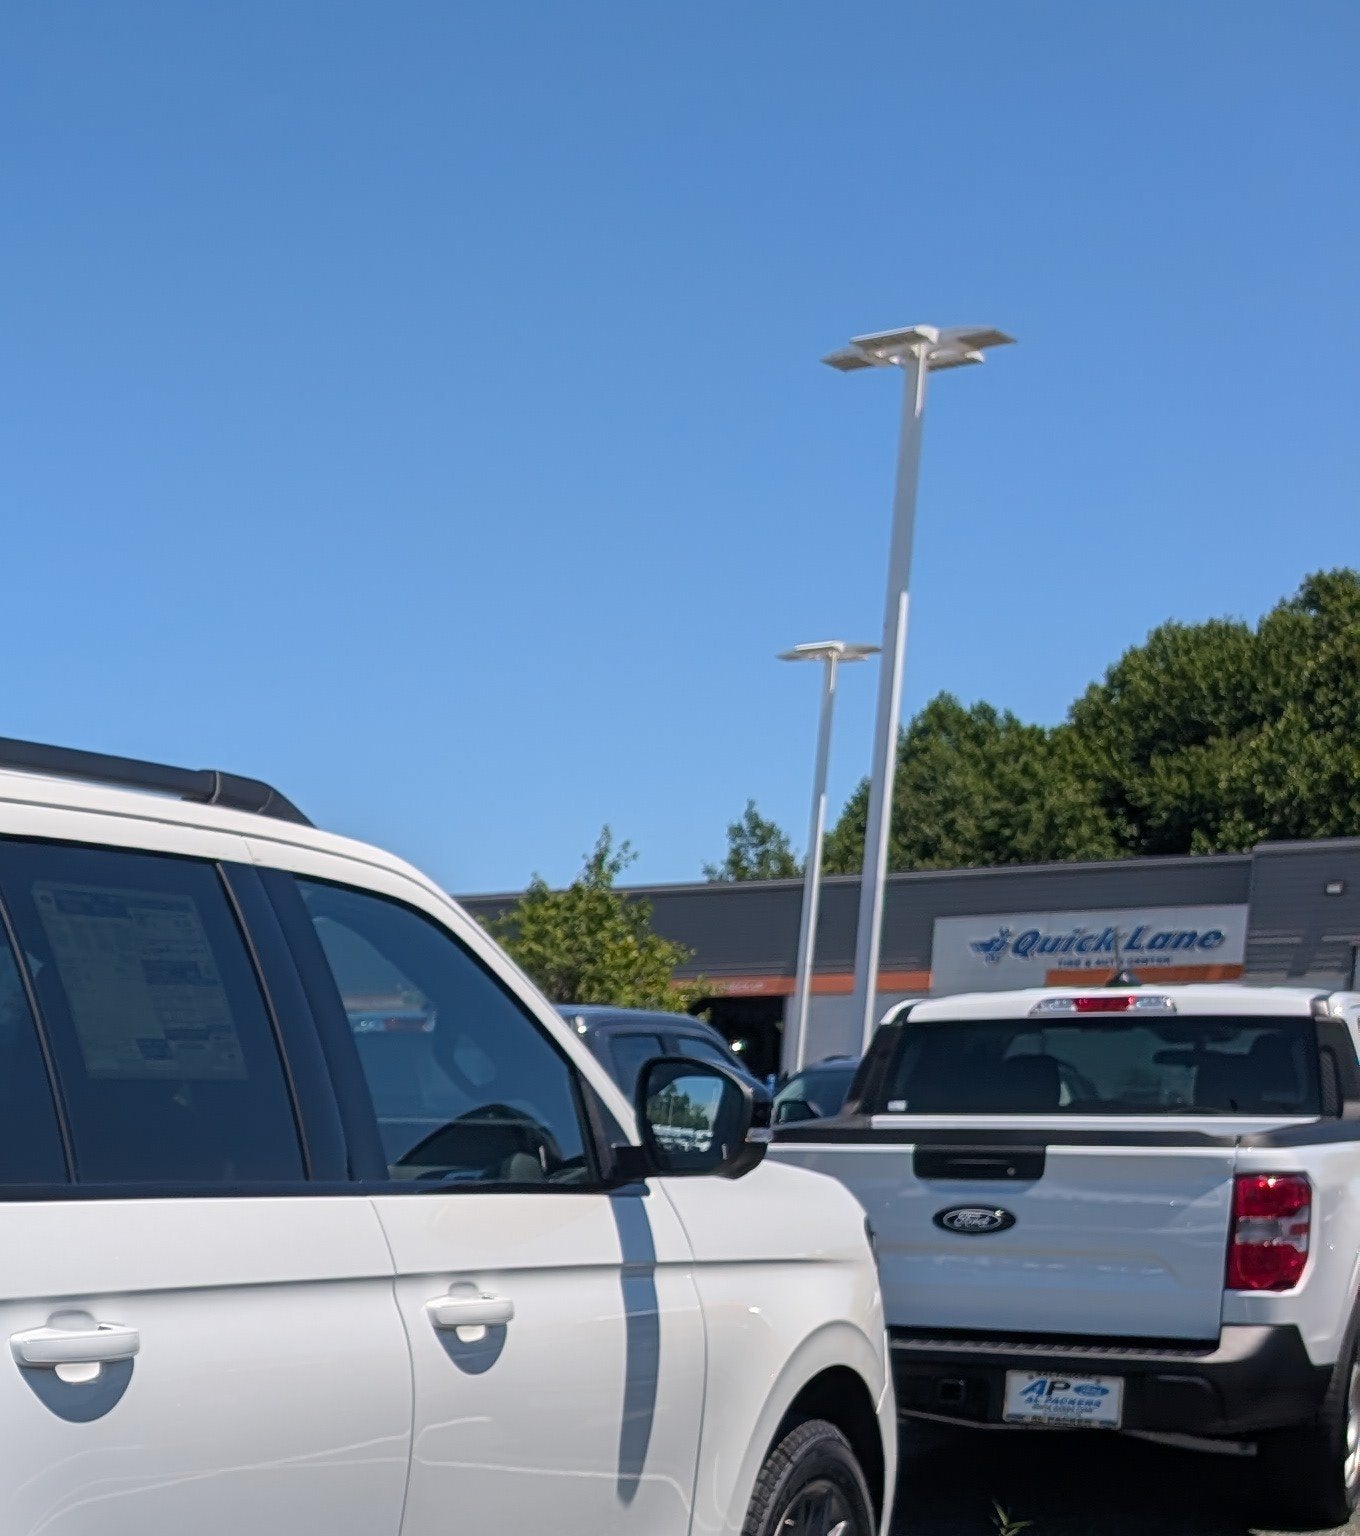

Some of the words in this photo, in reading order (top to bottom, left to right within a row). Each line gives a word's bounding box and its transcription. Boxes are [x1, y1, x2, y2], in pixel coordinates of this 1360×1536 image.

[1012, 926, 1117, 959] Quick
[1123, 925, 1226, 951] Lane
[1020, 1378, 1071, 1397] AP
